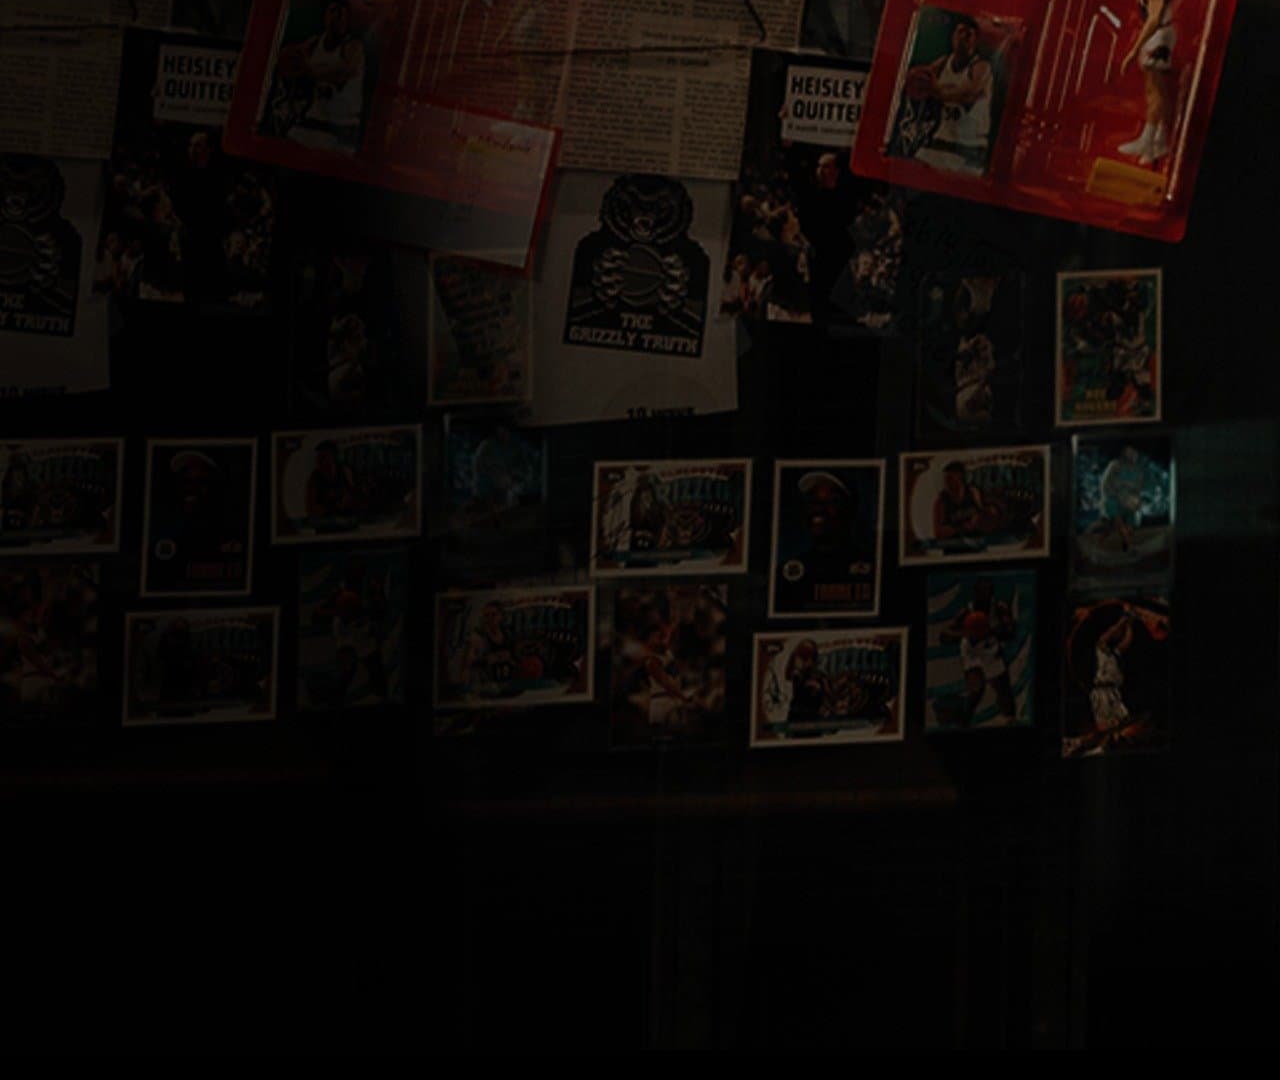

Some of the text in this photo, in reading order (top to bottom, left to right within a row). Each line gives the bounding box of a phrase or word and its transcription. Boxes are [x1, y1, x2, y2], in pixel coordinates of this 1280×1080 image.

[164, 55, 236, 76] HEISLEY
[791, 76, 864, 98] HEISLEY
[568, 324, 700, 355] GRIZZLY TRUTH
